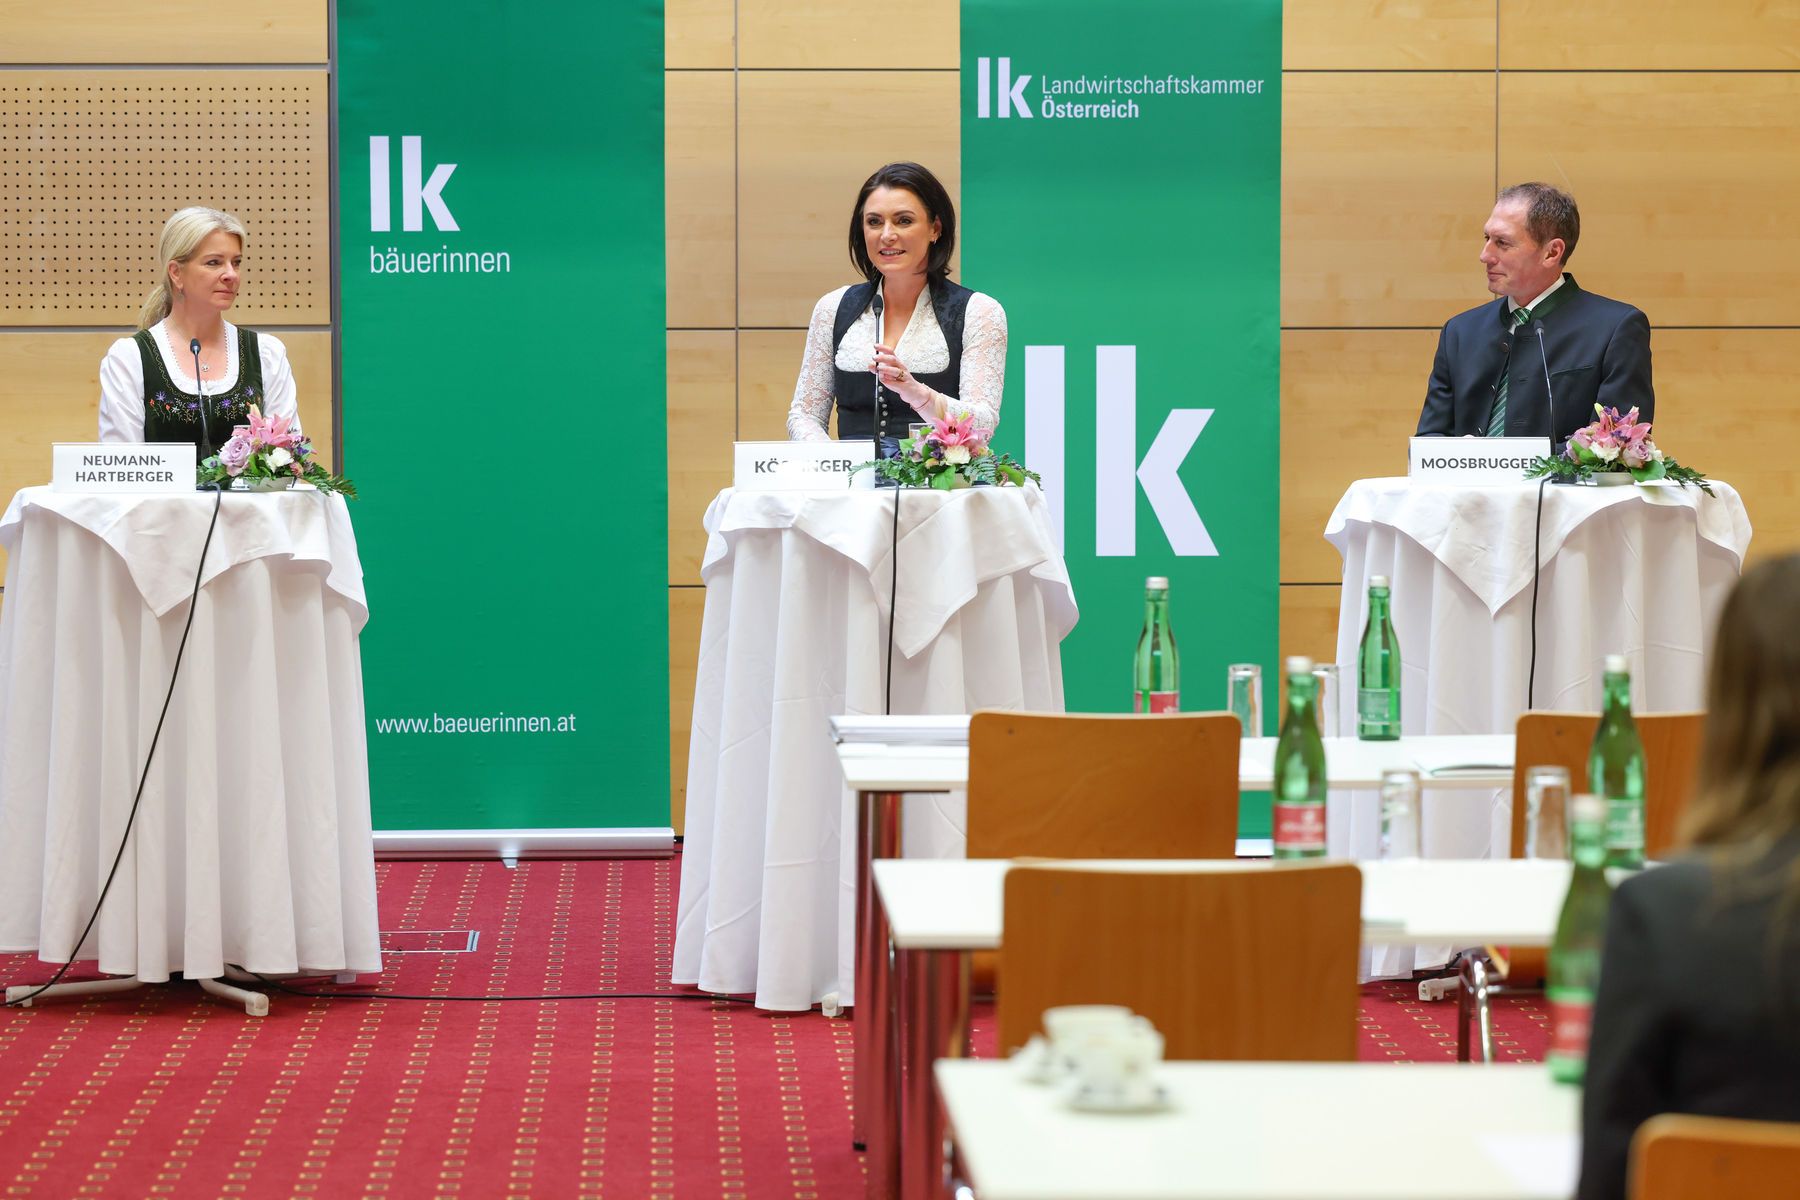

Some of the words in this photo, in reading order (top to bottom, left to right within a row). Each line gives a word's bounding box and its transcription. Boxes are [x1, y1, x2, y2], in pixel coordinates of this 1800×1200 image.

[977, 57, 1034, 118] lk
[1042, 75, 1264, 94] Landwirtschaftskammer
[1041, 95, 1139, 118] Österreich
[369, 135, 461, 232] lk
[370, 245, 511, 273] bäuerinnen
[83, 455, 167, 466] NEUMANN-
[1025, 345, 1220, 557] lk
[754, 458, 852, 473] KÖNGER
[75, 471, 174, 483] HARTBERGER
[375, 712, 577, 734] www.baeuerinnen.at
